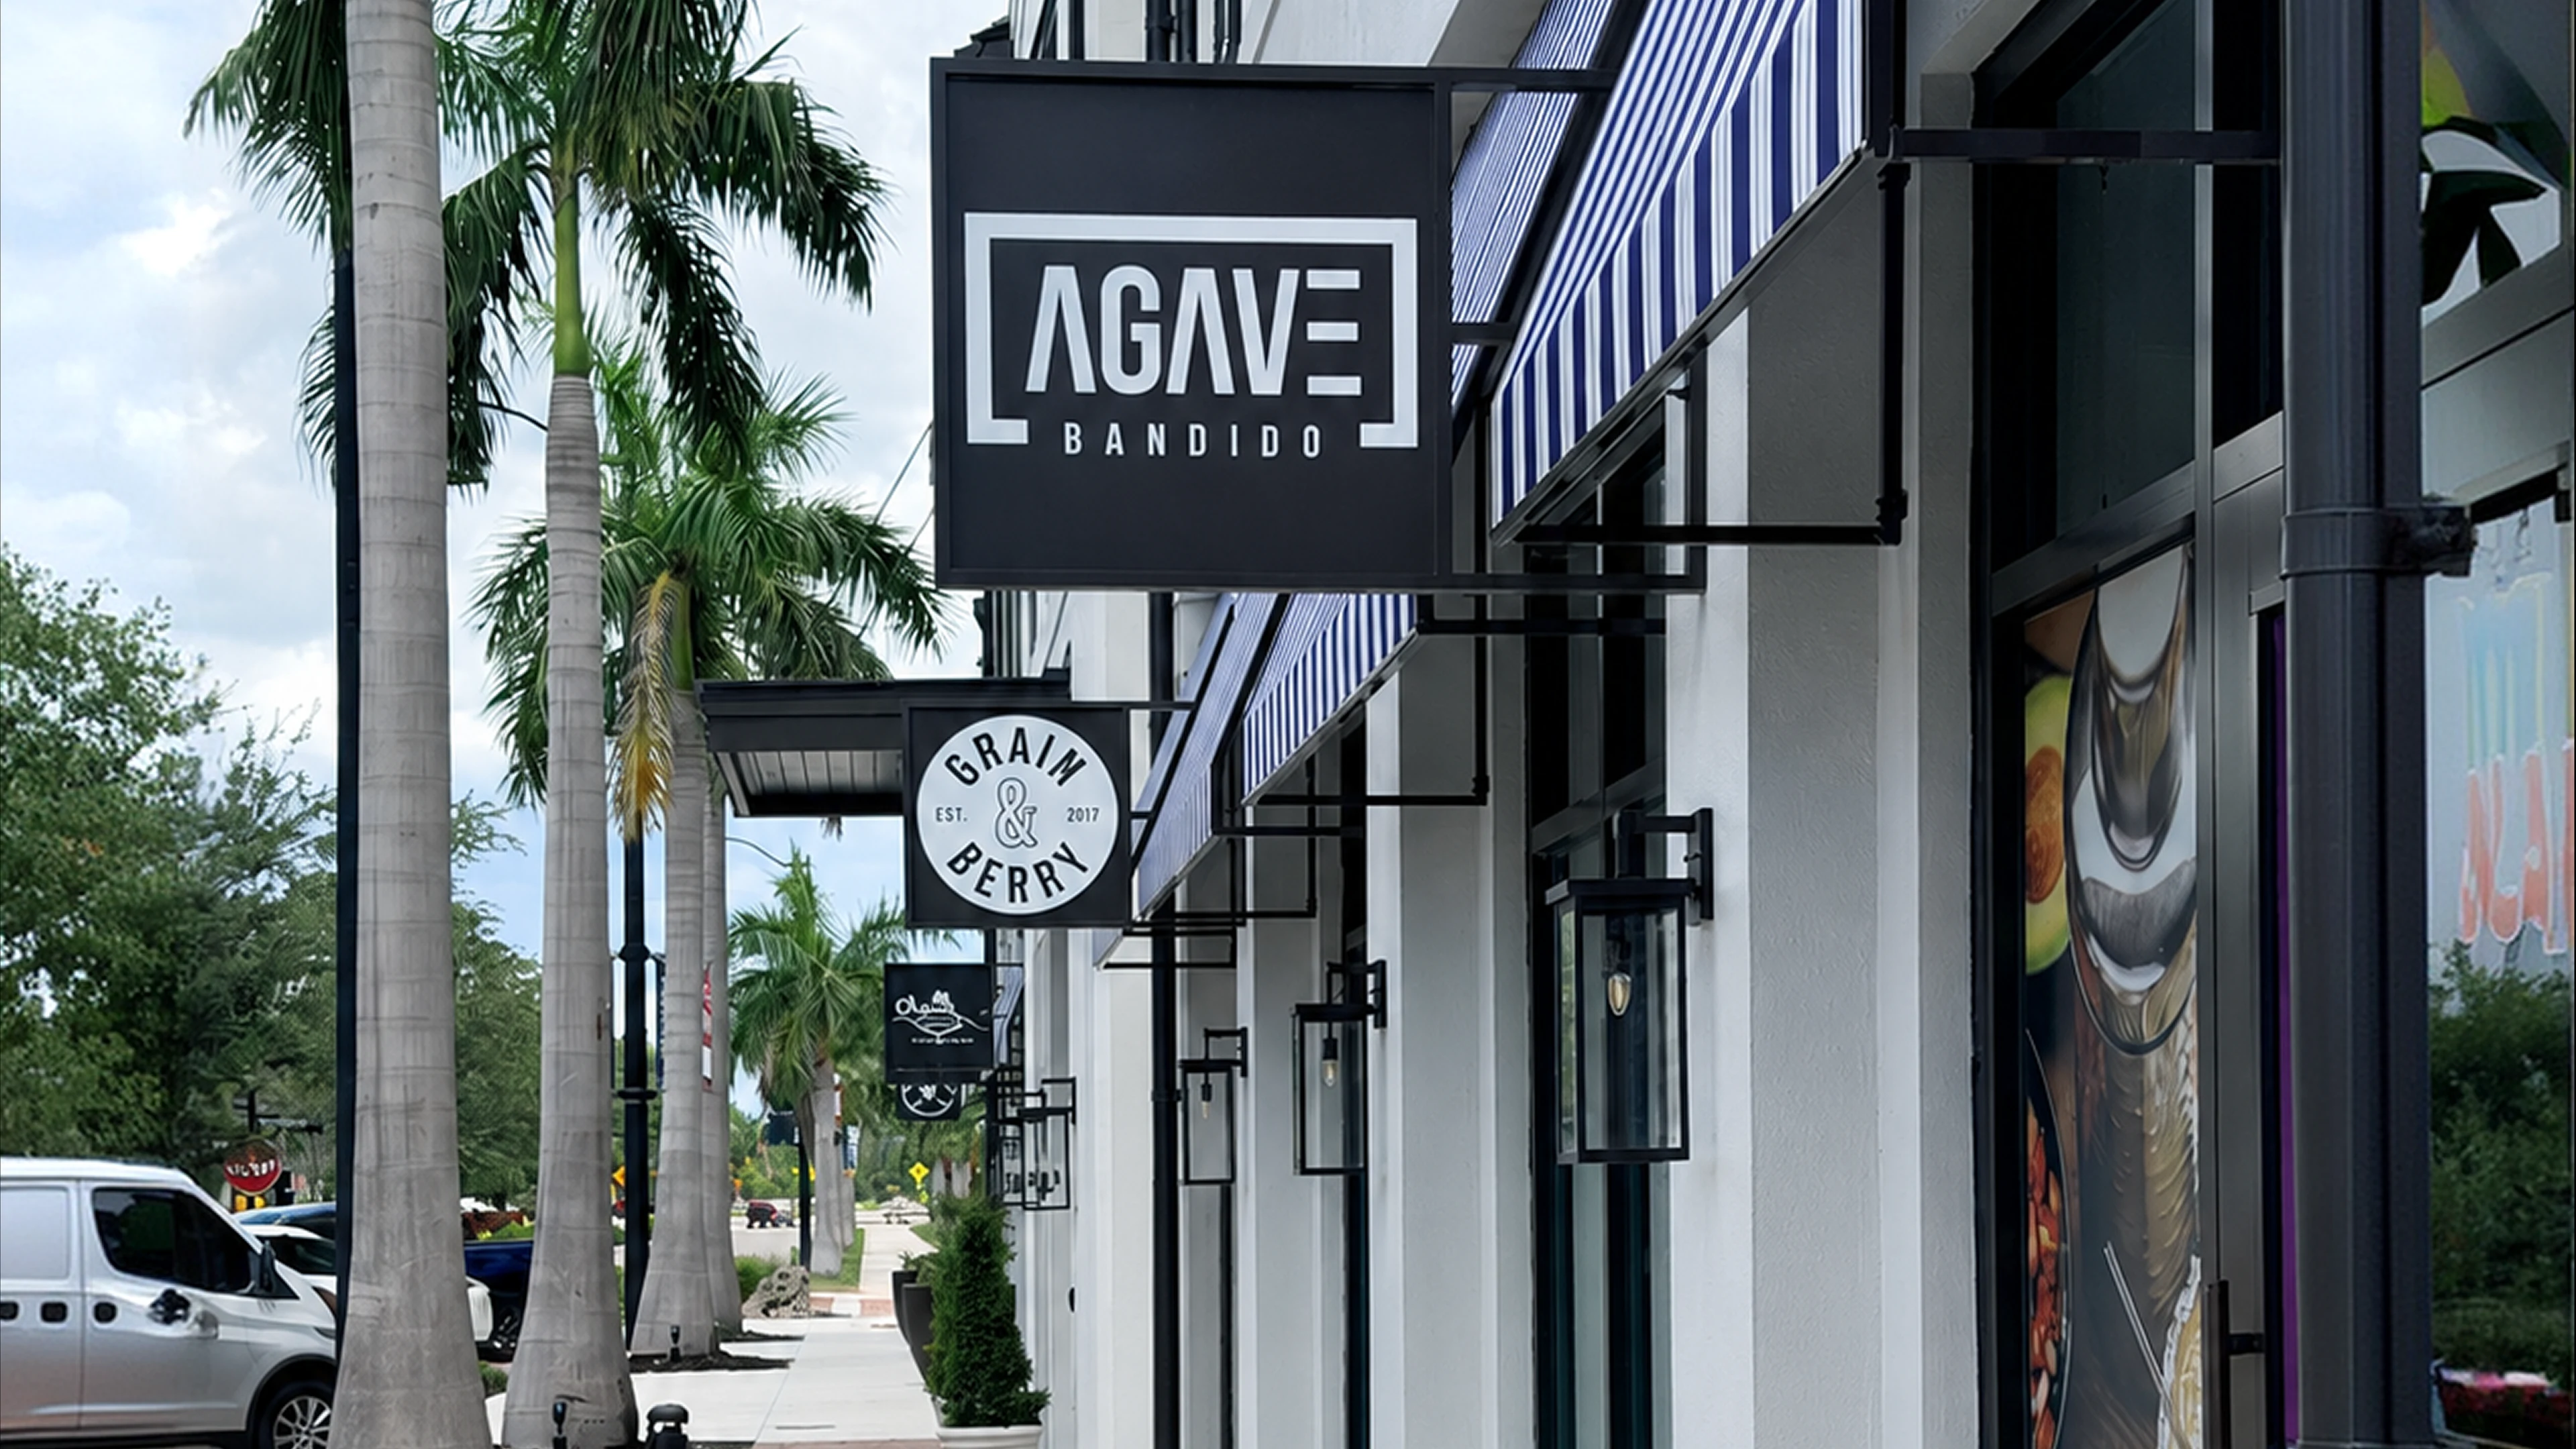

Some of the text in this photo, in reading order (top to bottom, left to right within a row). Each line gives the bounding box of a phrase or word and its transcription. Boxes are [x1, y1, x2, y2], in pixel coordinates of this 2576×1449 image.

[1025, 265, 1362, 396] AGAVE
[1064, 422, 1321, 458] BANDIDO
[945, 727, 1087, 786] GRAIN
[936, 807, 1099, 822] EST. 2017
[995, 777, 1038, 849] &
[947, 841, 1088, 904] BERRY
